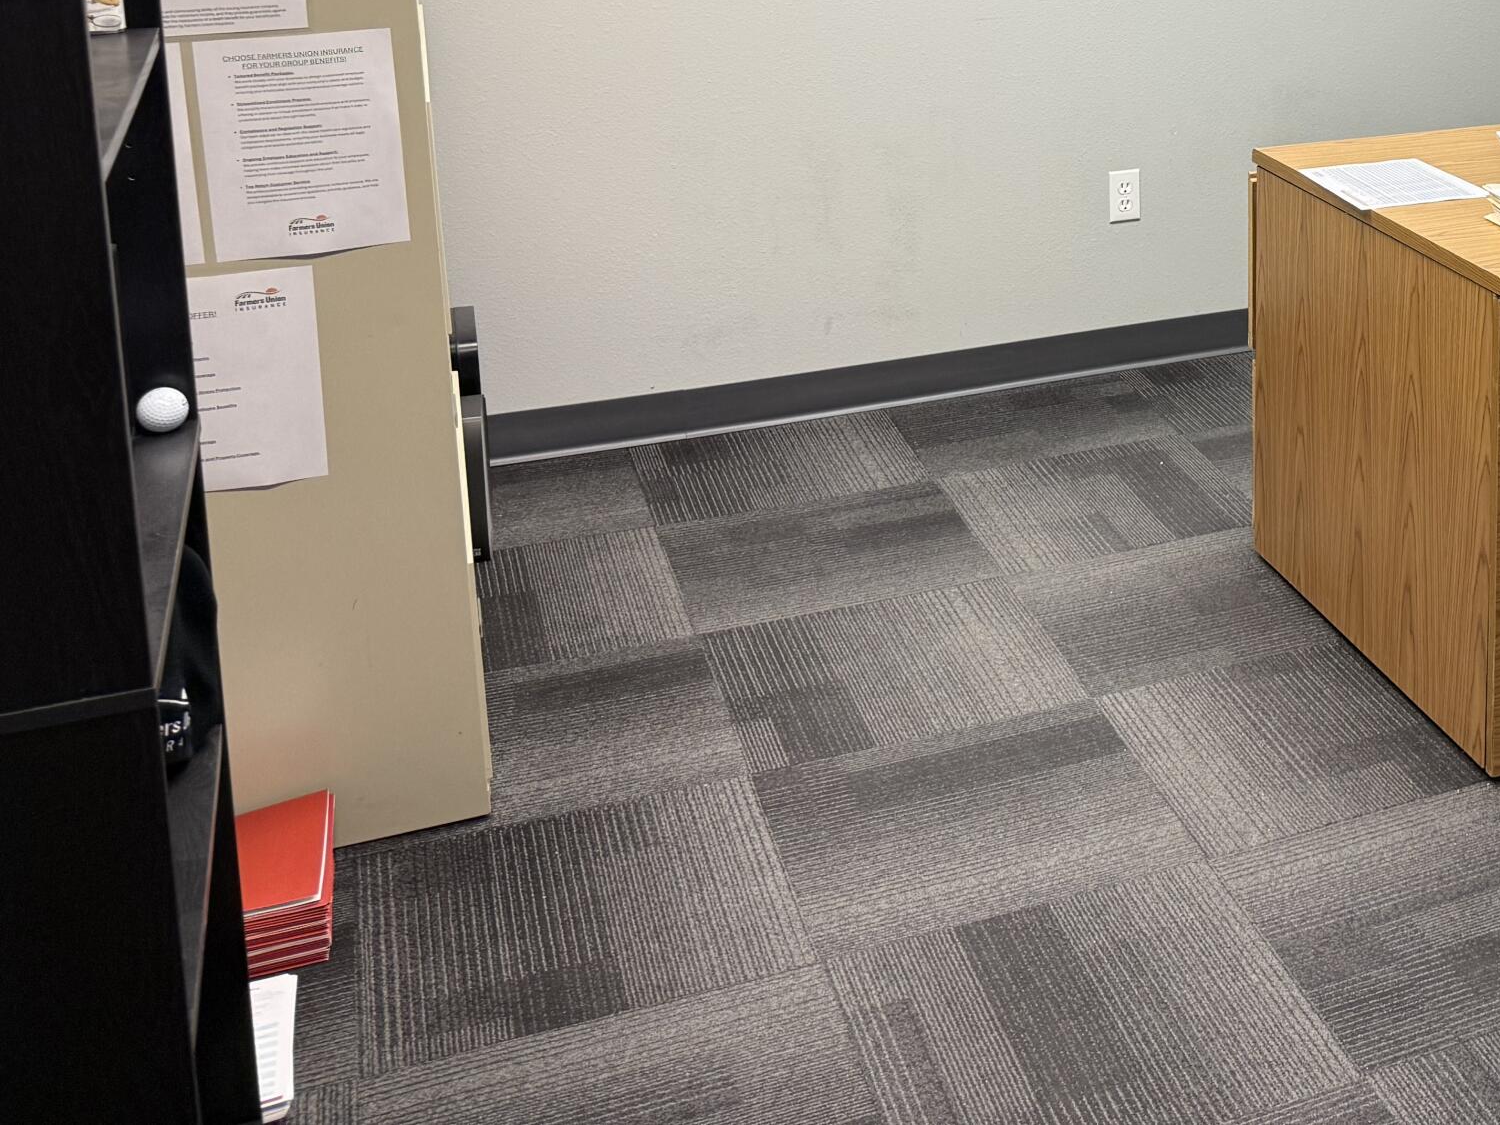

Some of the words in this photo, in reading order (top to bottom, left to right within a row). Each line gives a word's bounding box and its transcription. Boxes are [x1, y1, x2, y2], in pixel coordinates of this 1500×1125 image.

[222, 53, 257, 62] CHOOSE
[258, 51, 292, 60] FARMERS
[294, 50, 319, 58] UNION
[320, 46, 363, 57] INSURANCE
[259, 61, 280, 69] YOUR
[282, 59, 309, 67] GROUP
